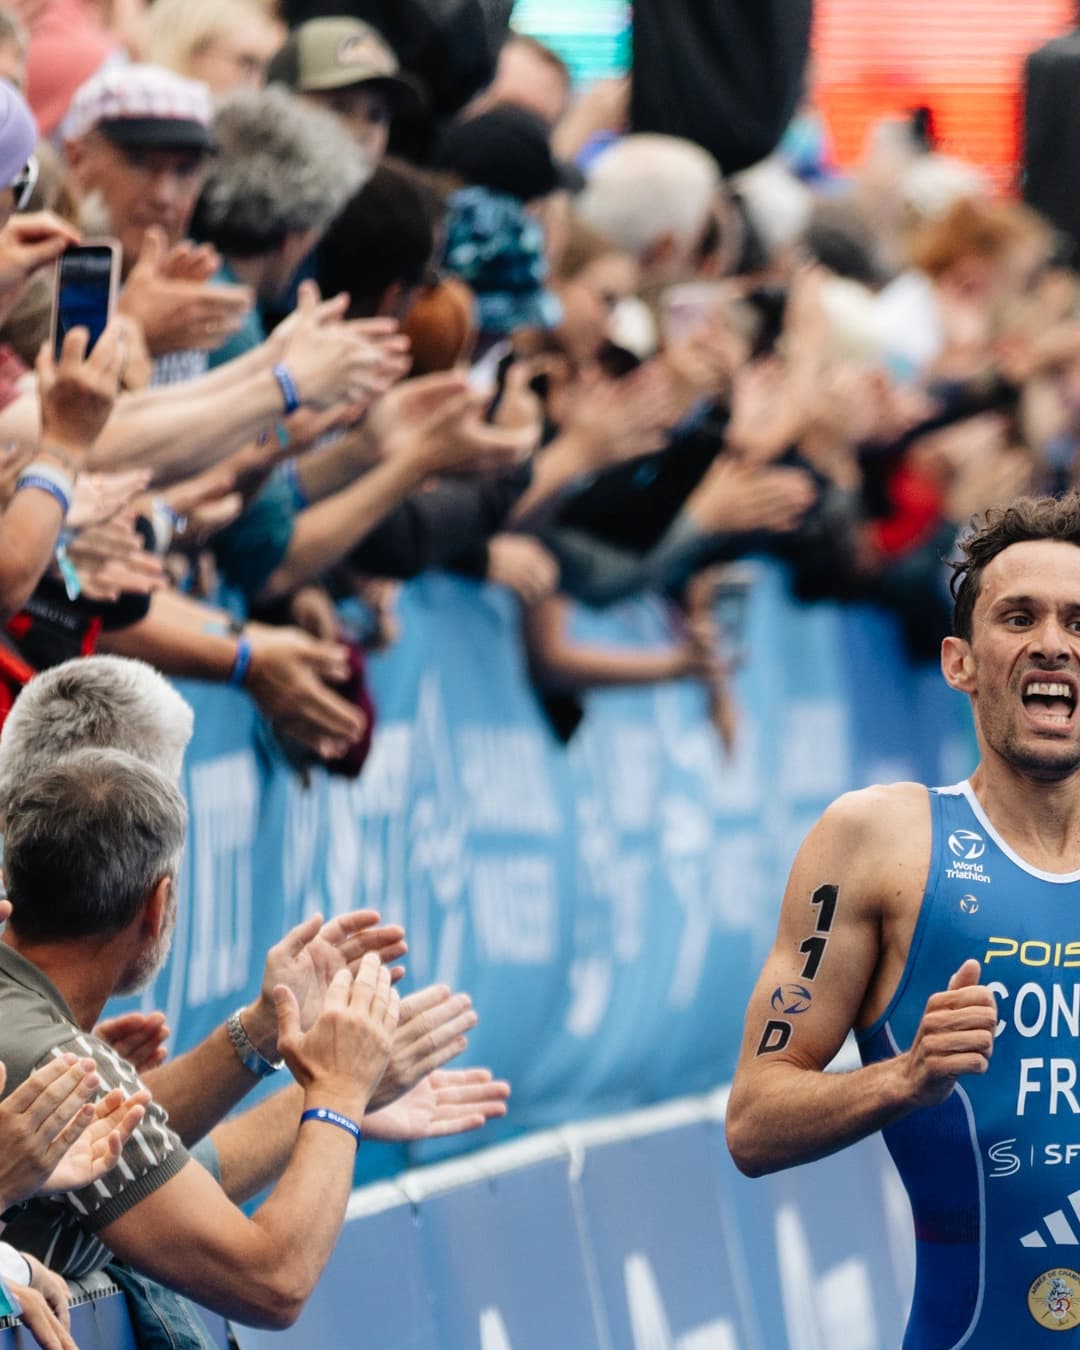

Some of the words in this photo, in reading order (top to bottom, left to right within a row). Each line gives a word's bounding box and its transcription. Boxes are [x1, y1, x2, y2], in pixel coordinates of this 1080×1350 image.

[953, 860, 983, 873] World
[945, 869, 991, 884] Triathlon
[755, 1019, 793, 1058] D
